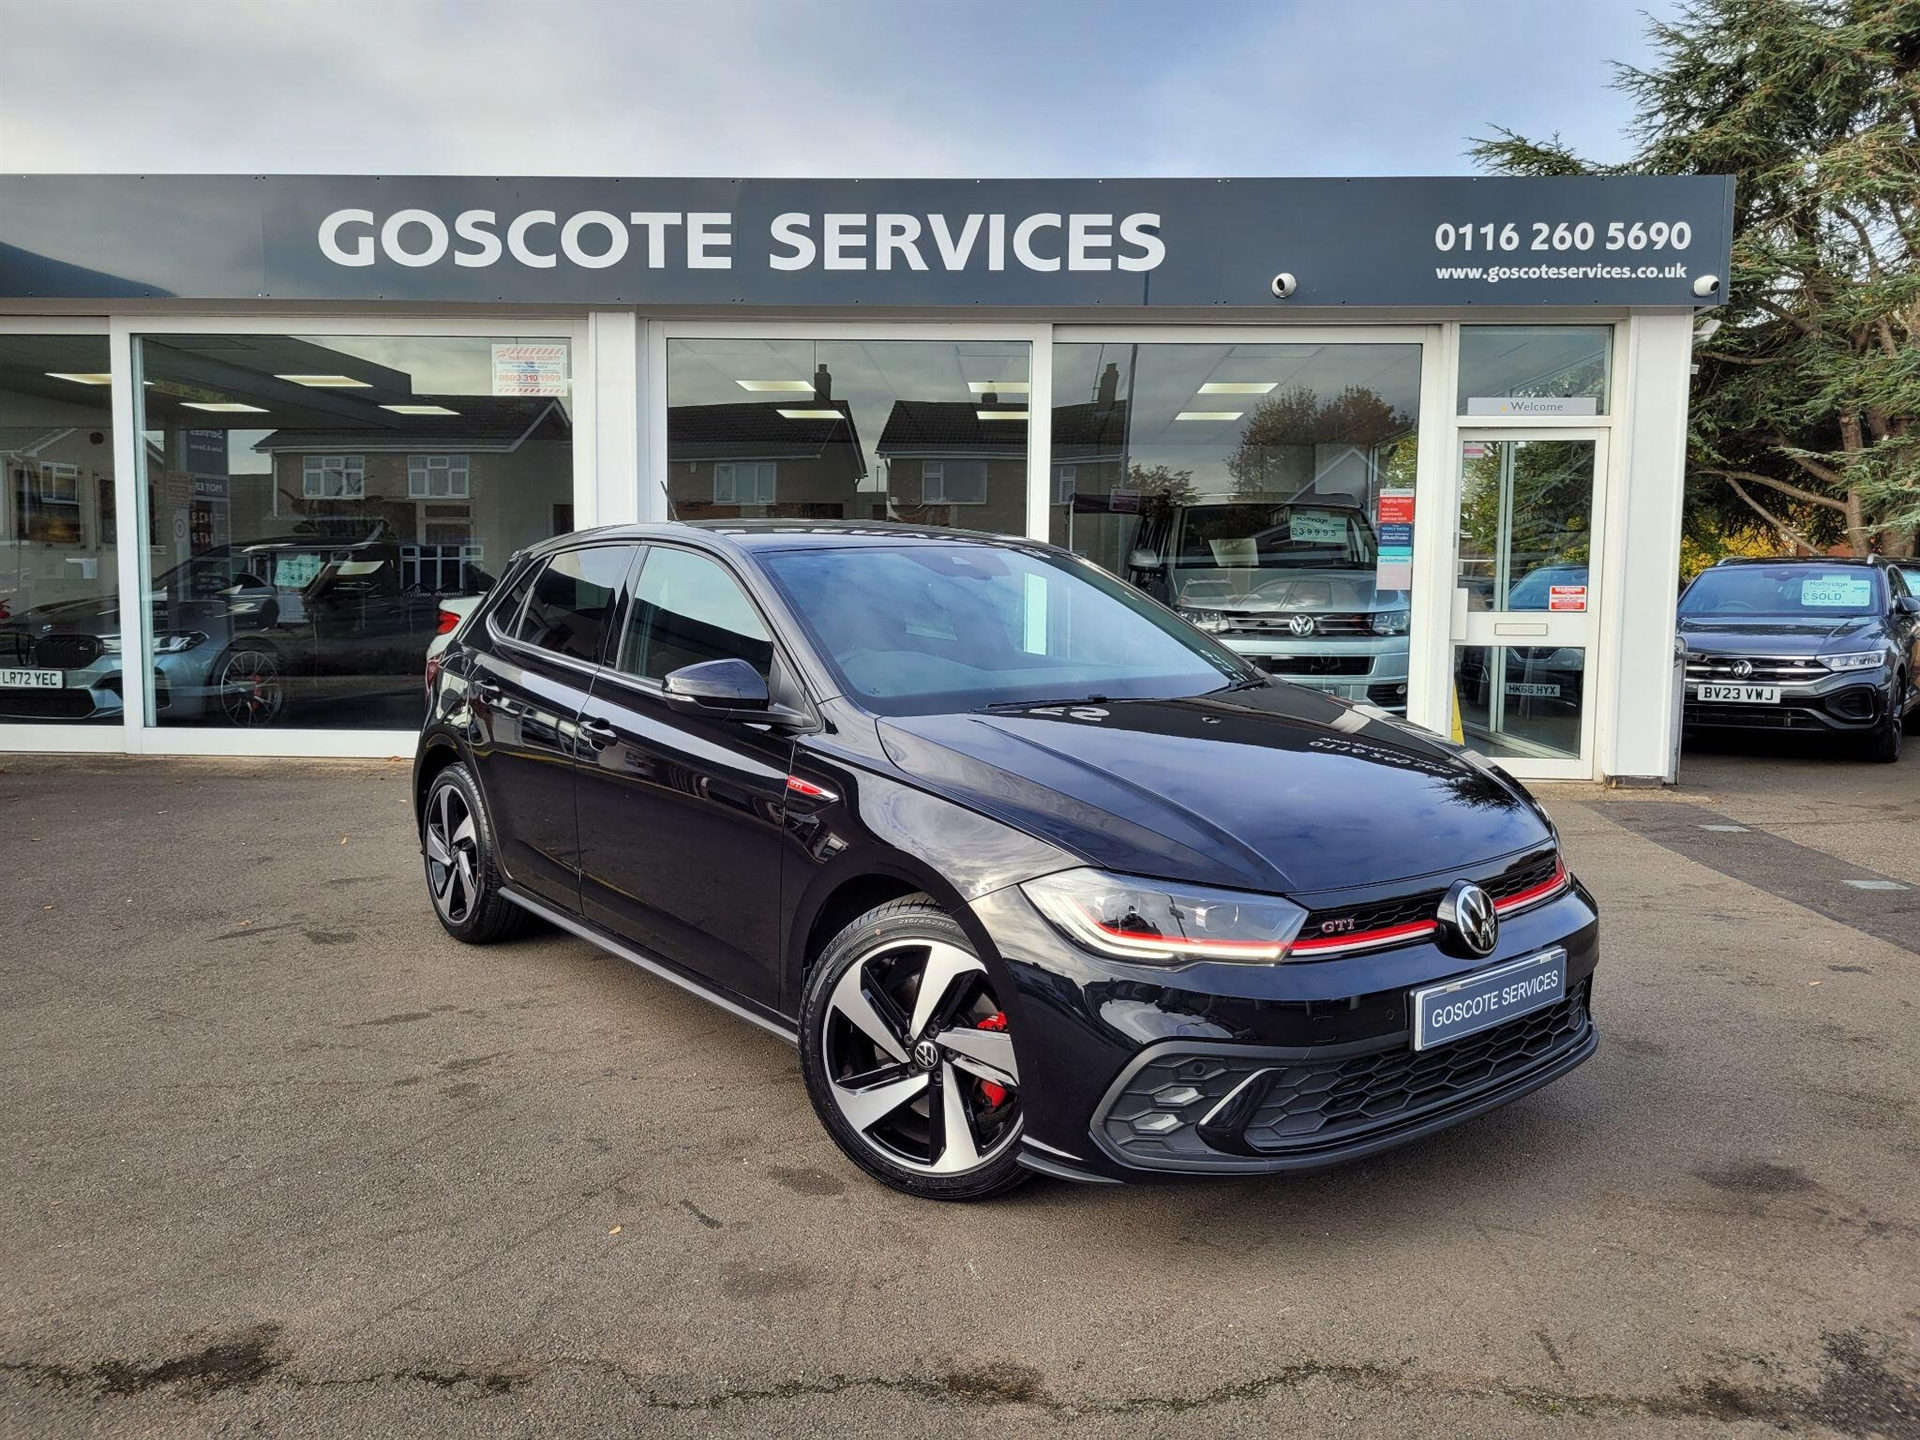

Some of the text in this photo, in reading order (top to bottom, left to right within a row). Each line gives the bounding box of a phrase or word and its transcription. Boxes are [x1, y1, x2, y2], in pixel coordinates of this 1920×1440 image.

[318, 208, 1166, 272] GOSCOTE SERVICES
[1435, 221, 1692, 251] 0116 260 5690
[1435, 262, 1687, 283] www.goscoteservices.co.uk
[499, 374, 561, 382] 0800 310 1999
[1510, 401, 1564, 412] Welcome
[1809, 580, 1848, 588] Northridge
[2, 671, 57, 686] LR72 YEC
[1509, 684, 1556, 695] HK66 HYX
[1704, 687, 1774, 701] BV23 VWJ
[1322, 918, 1355, 934] GTI
[1432, 970, 1559, 1028] GOSCOTE SERVICES
